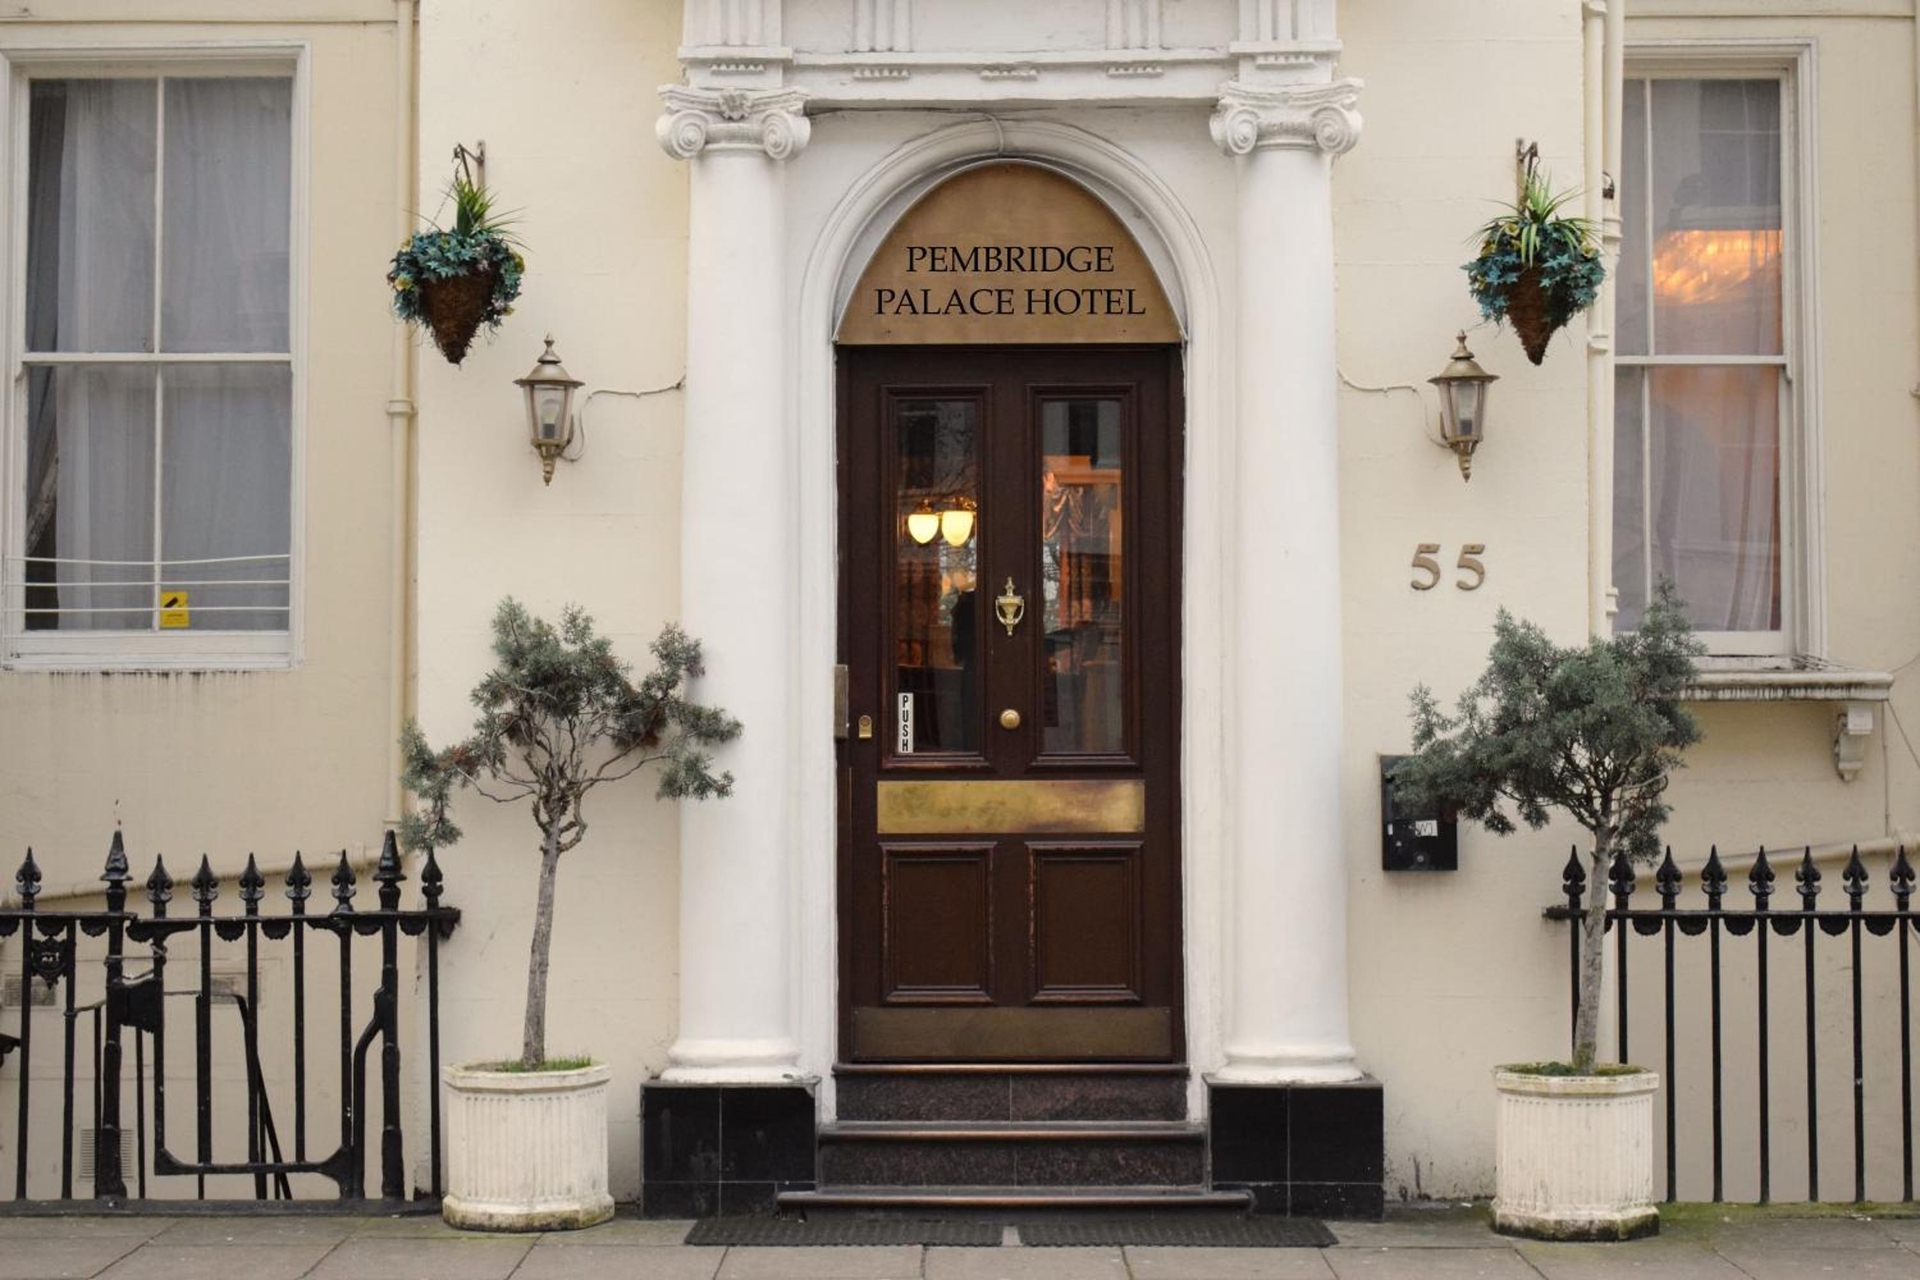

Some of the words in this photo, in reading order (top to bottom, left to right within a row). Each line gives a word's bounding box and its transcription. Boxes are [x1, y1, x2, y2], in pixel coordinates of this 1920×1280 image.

[906, 246, 1114, 273] PEMBRIDGE
[874, 288, 1015, 315] PALACE
[1024, 288, 1146, 315] HOTEL
[1410, 543, 1486, 591] 55
[901, 695, 910, 752] PUSH
